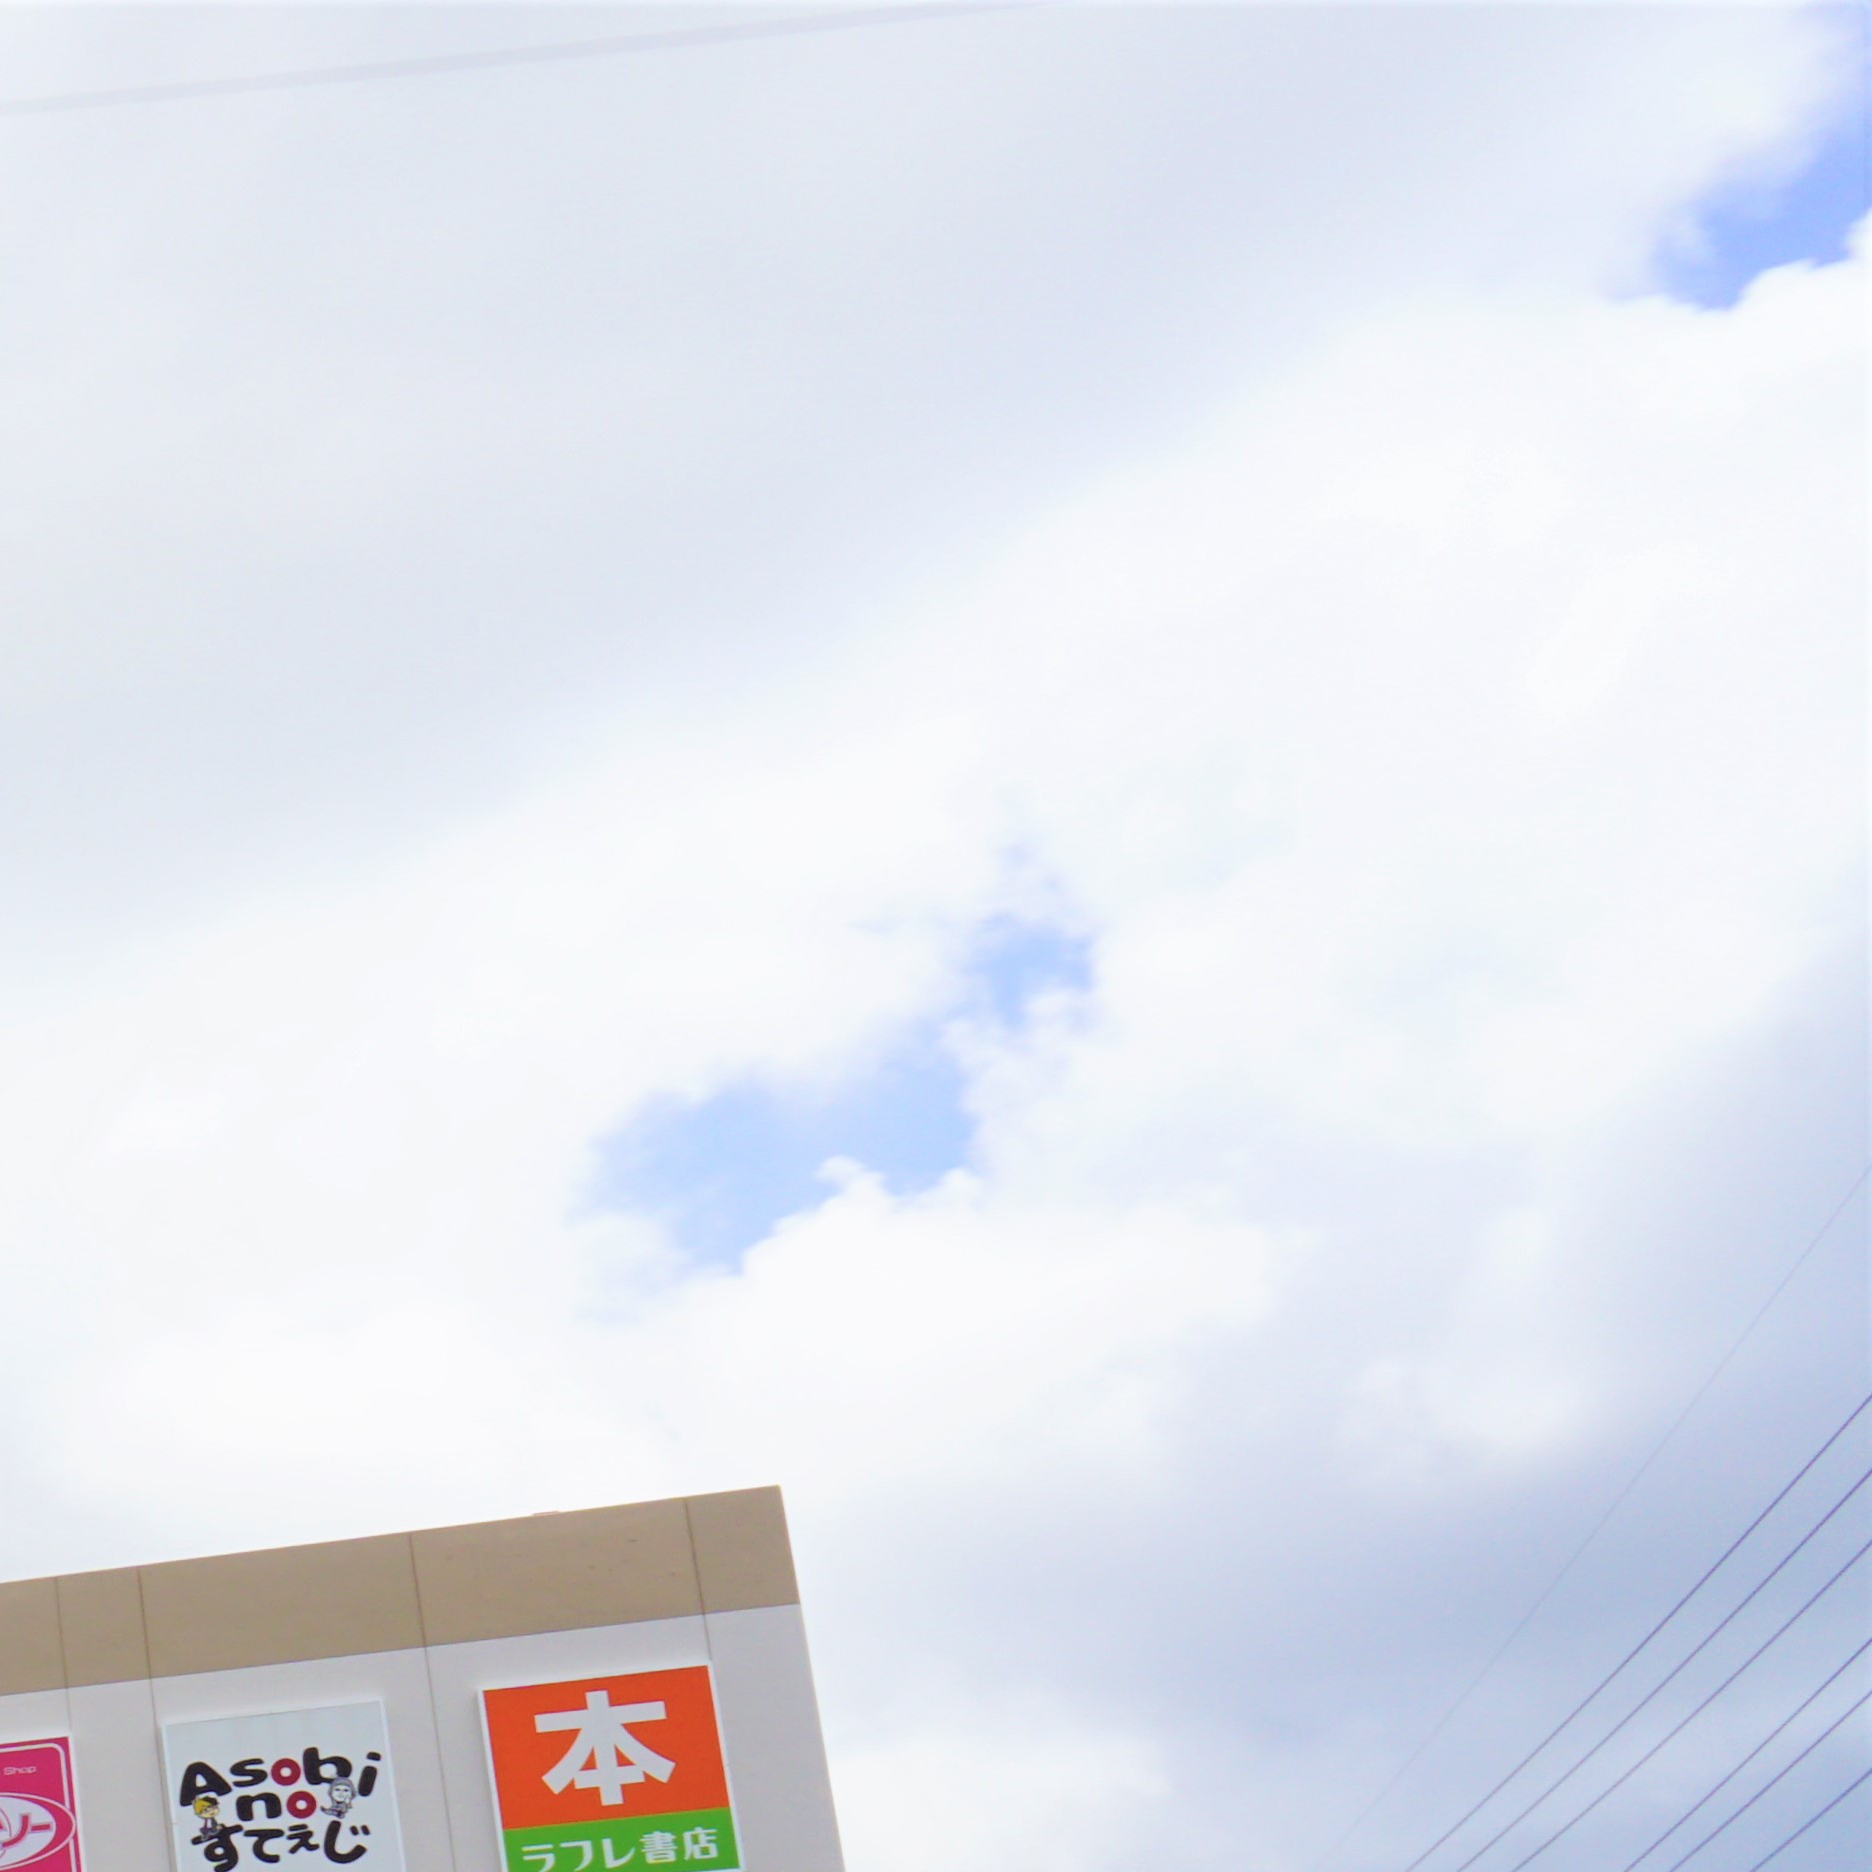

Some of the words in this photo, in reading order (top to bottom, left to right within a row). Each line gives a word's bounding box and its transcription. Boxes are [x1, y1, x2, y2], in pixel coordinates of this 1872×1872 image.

[534, 1689, 676, 1806] 本
[3, 1765, 37, 1777] Shop
[180, 1747, 382, 1807] Asobi
[236, 1790, 318, 1821] no
